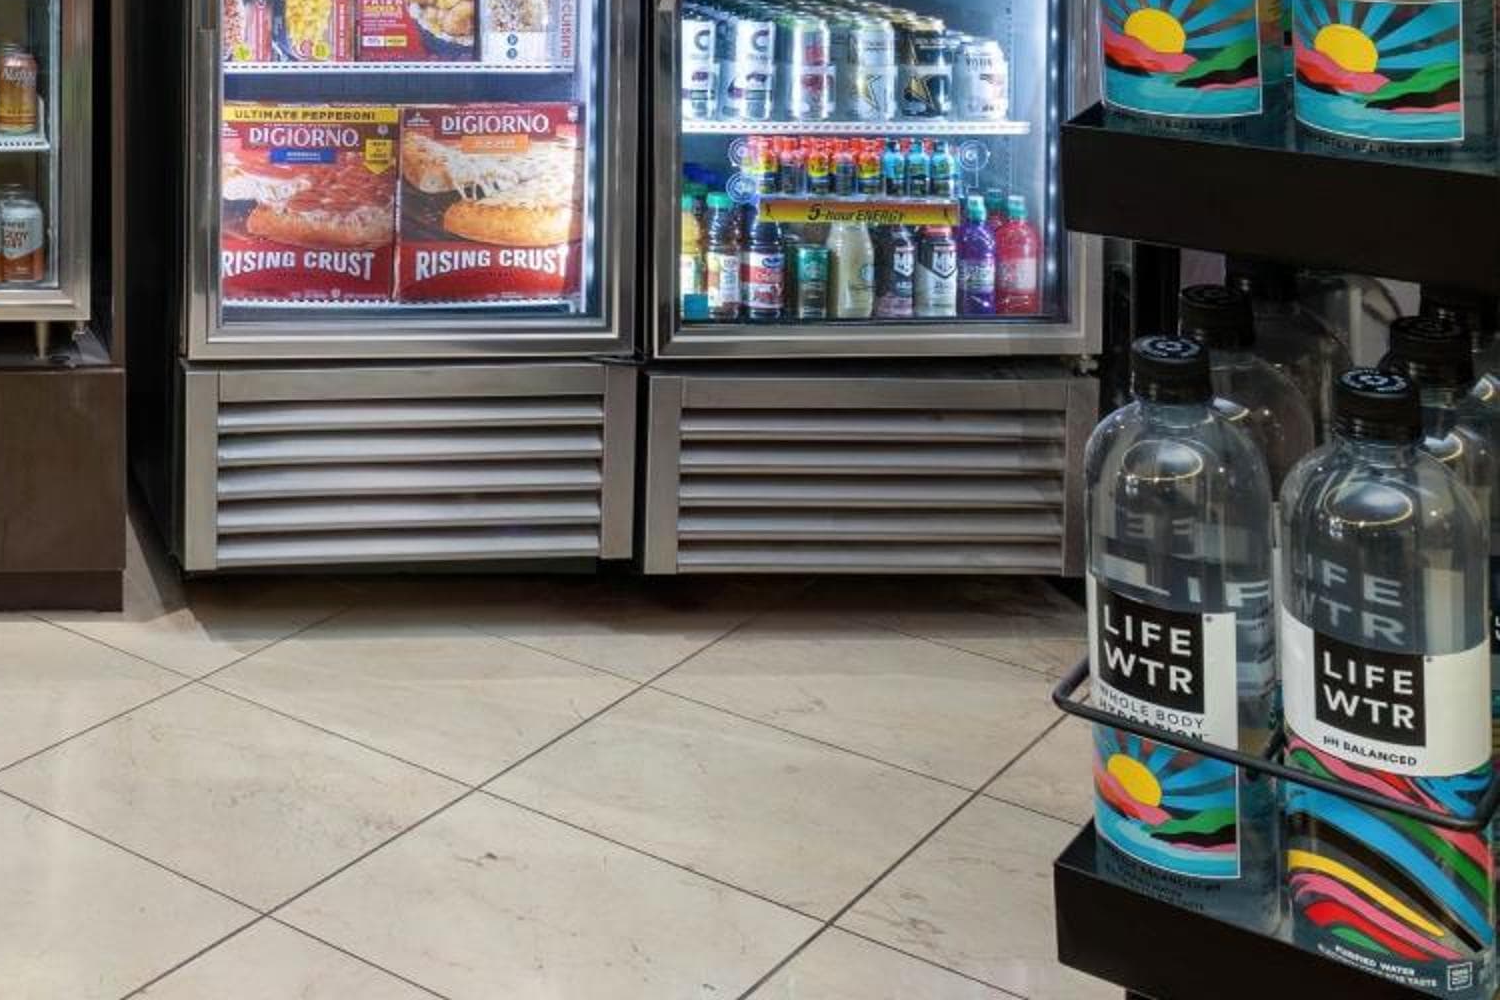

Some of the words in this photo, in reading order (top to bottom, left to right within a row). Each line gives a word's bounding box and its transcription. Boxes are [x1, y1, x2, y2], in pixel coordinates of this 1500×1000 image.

[235, 109, 298, 120] ULTIMATE
[302, 109, 376, 121] PEPPERONI
[221, 249, 296, 279] RISING
[303, 251, 376, 281] CRUST
[415, 249, 492, 281] RISING
[499, 247, 570, 275] CRUST
[1104, 603, 1192, 657] LIFE
[1104, 640, 1193, 695] WTR
[1323, 651, 1414, 696] LIFE
[1100, 686, 1150, 717] WHOLE
[1155, 710, 1205, 730] BODY
[1323, 683, 1415, 730] WTR
[1343, 740, 1417, 766] BALANCED
[1379, 962, 1416, 977] WATER
